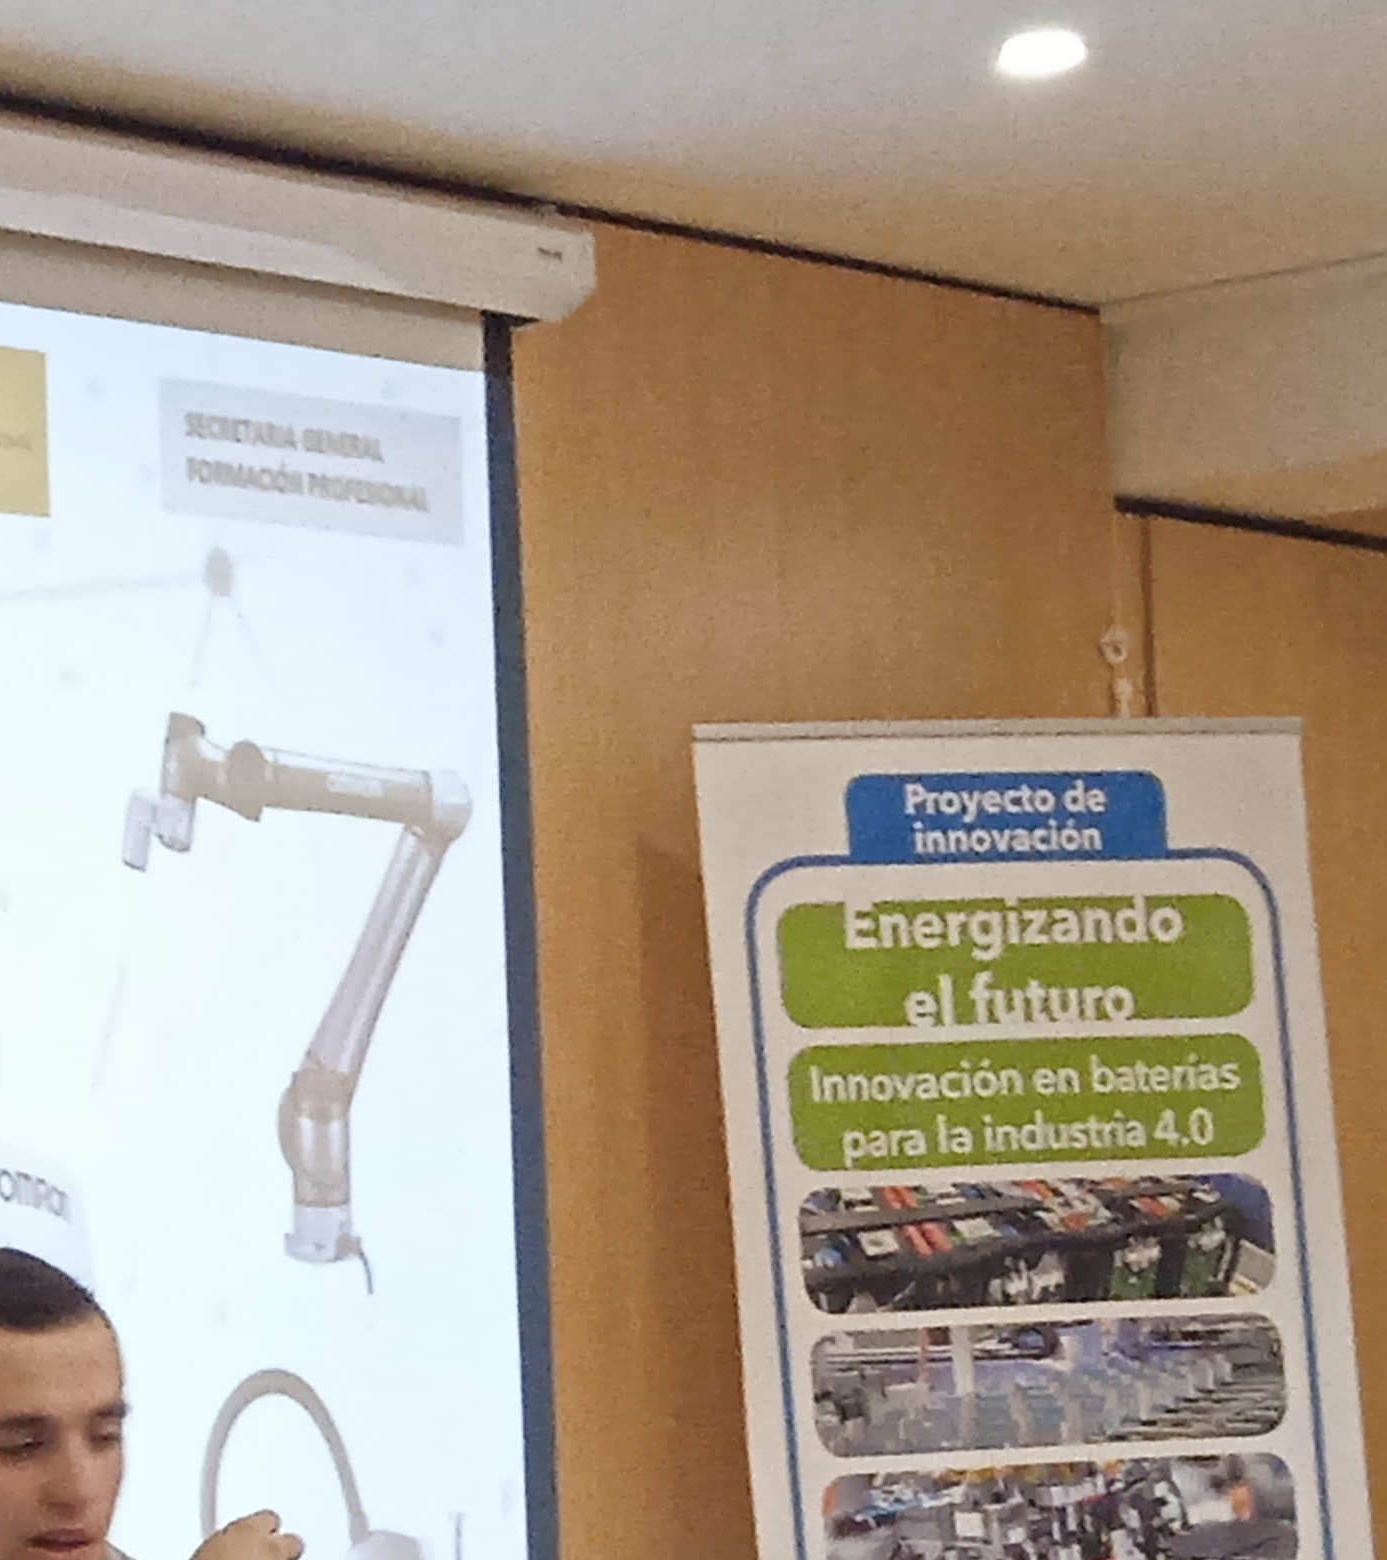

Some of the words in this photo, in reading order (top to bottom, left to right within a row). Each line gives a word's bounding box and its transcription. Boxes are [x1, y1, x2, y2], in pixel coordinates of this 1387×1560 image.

[904, 783, 1055, 822] Proyecto
[1064, 781, 1106, 811] de
[914, 821, 1102, 854] innovación
[842, 896, 1184, 959] Energizando
[905, 975, 953, 1026] el
[971, 971, 1134, 1025] futuro
[810, 1059, 1024, 1101] Innovación
[1035, 1064, 1080, 1094] en
[1092, 1053, 1241, 1094] baterías
[842, 1123, 926, 1168] para
[936, 1114, 971, 1154] la
[982, 1110, 1145, 1153] industria
[1153, 1107, 1214, 1146] 4.0
